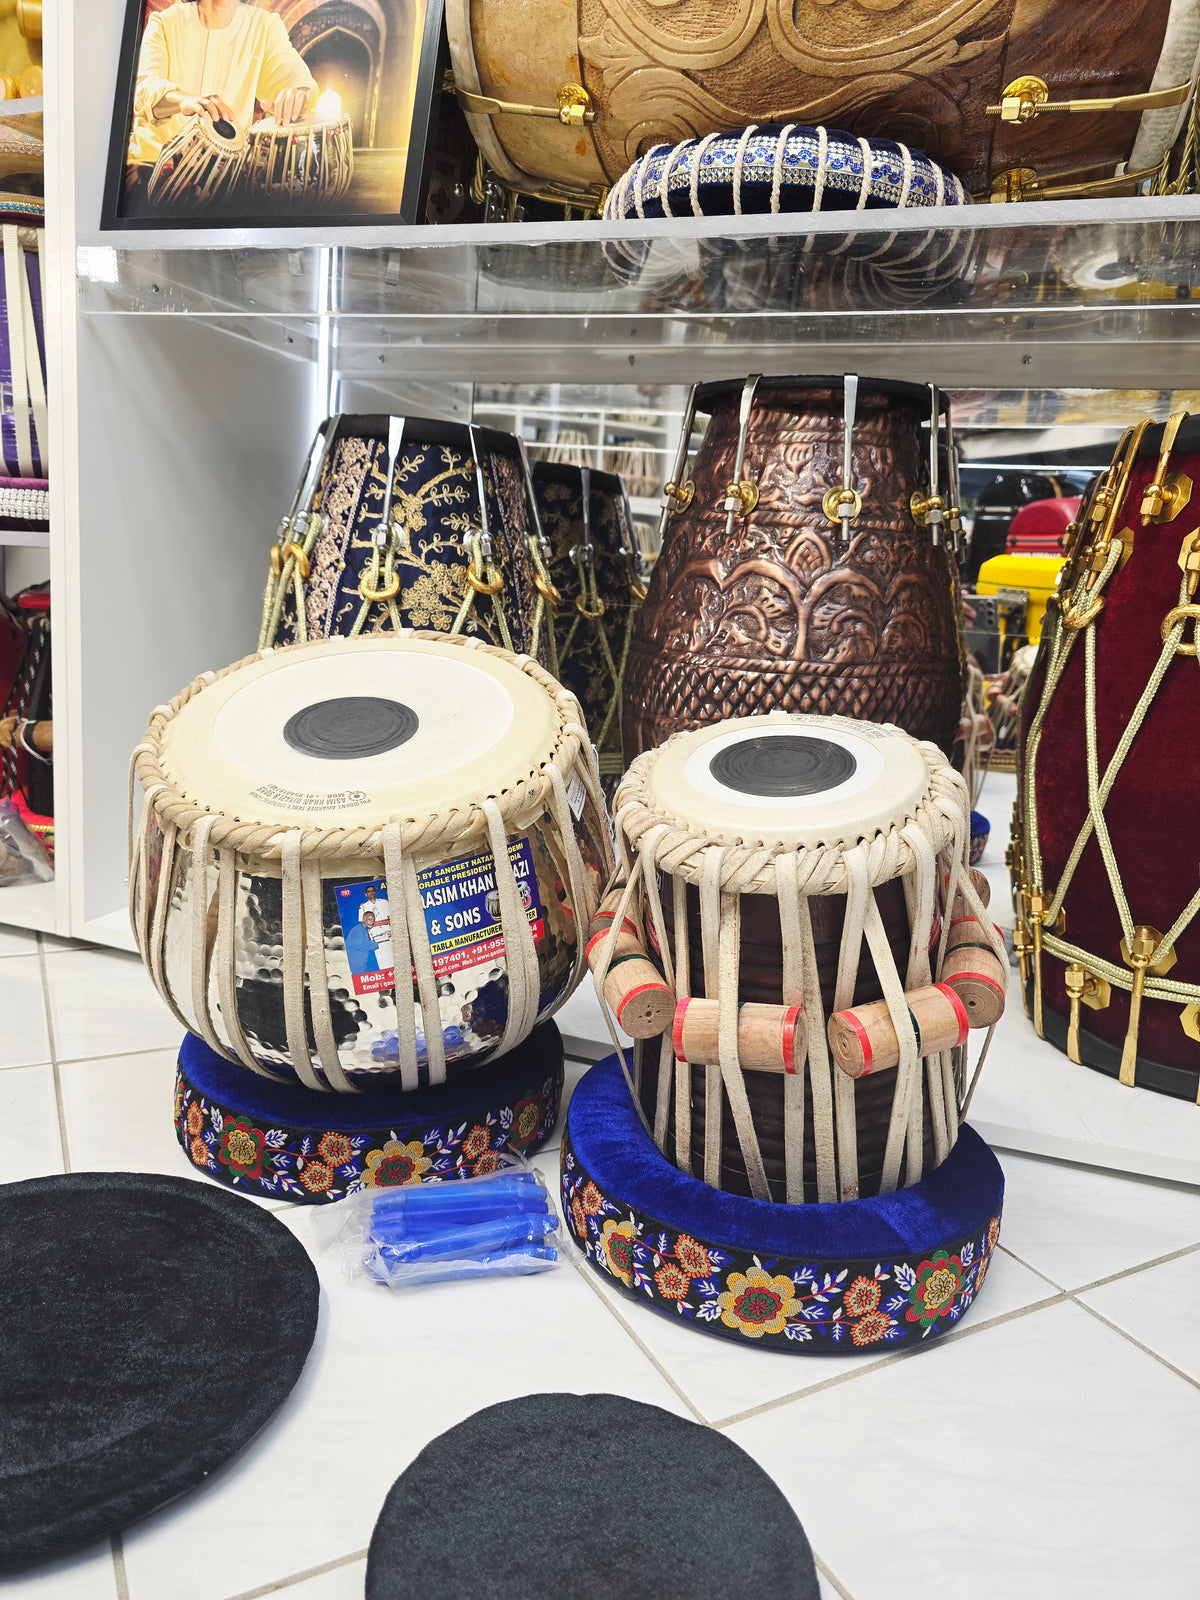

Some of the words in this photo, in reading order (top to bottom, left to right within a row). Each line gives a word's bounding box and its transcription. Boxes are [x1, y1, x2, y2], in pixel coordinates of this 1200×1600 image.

[304, 798, 324, 806] KHAN
[326, 797, 346, 805] ASIM
[418, 876, 450, 890] ORABLE
[452, 863, 492, 881] PRESIDENT
[510, 853, 521, 862] DIA
[422, 872, 432, 880] BY
[434, 862, 469, 878] SANGEET
[508, 842, 524, 853] DEMI
[459, 873, 494, 899] KHAN
[512, 860, 530, 880] AZI
[430, 918, 442, 936] &
[444, 907, 481, 932] SONS
[432, 941, 454, 953] TABLA
[360, 972, 385, 985] Mob:
[362, 982, 378, 991] Email
[462, 958, 473, 966] Web
[477, 948, 505, 962] www.qasim
